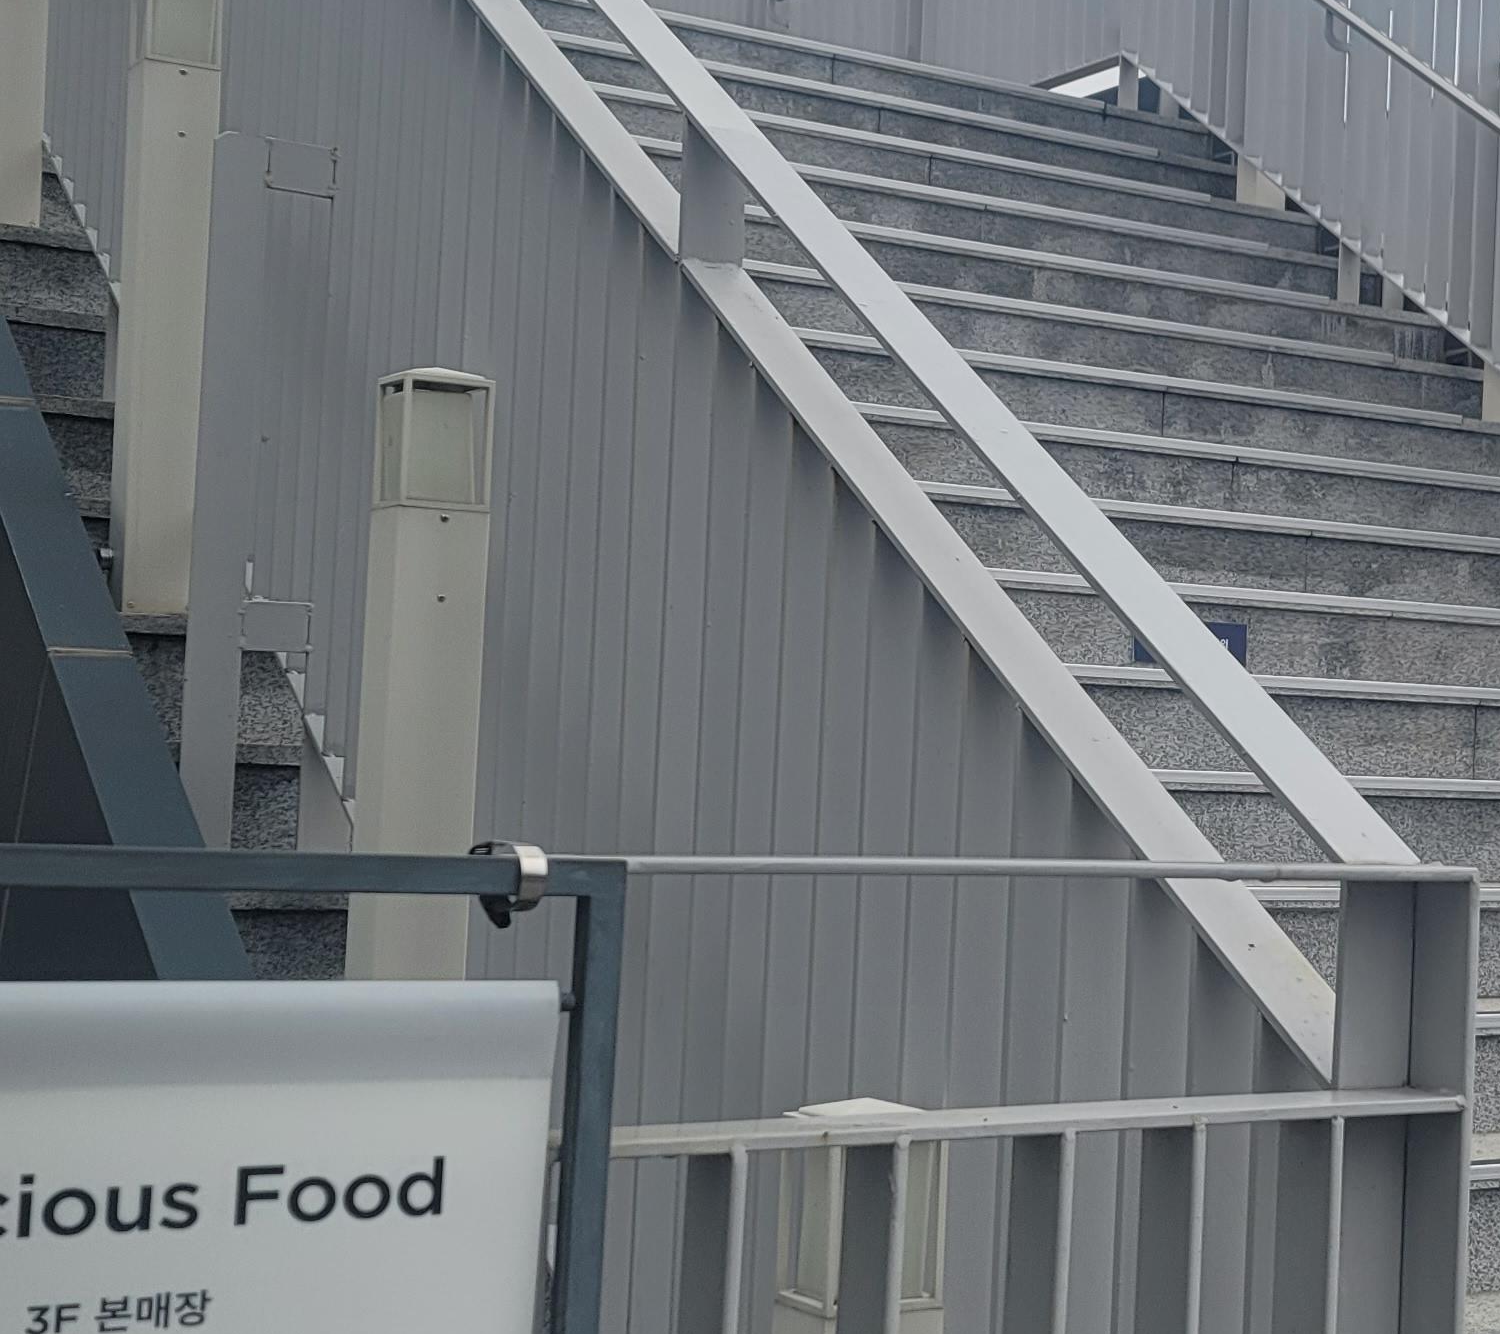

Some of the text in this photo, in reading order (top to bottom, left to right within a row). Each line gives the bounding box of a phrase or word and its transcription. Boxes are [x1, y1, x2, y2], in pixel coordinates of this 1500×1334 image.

[0, 1155, 446, 1238] ious Food
[25, 1289, 213, 1334] 3F 본매장
